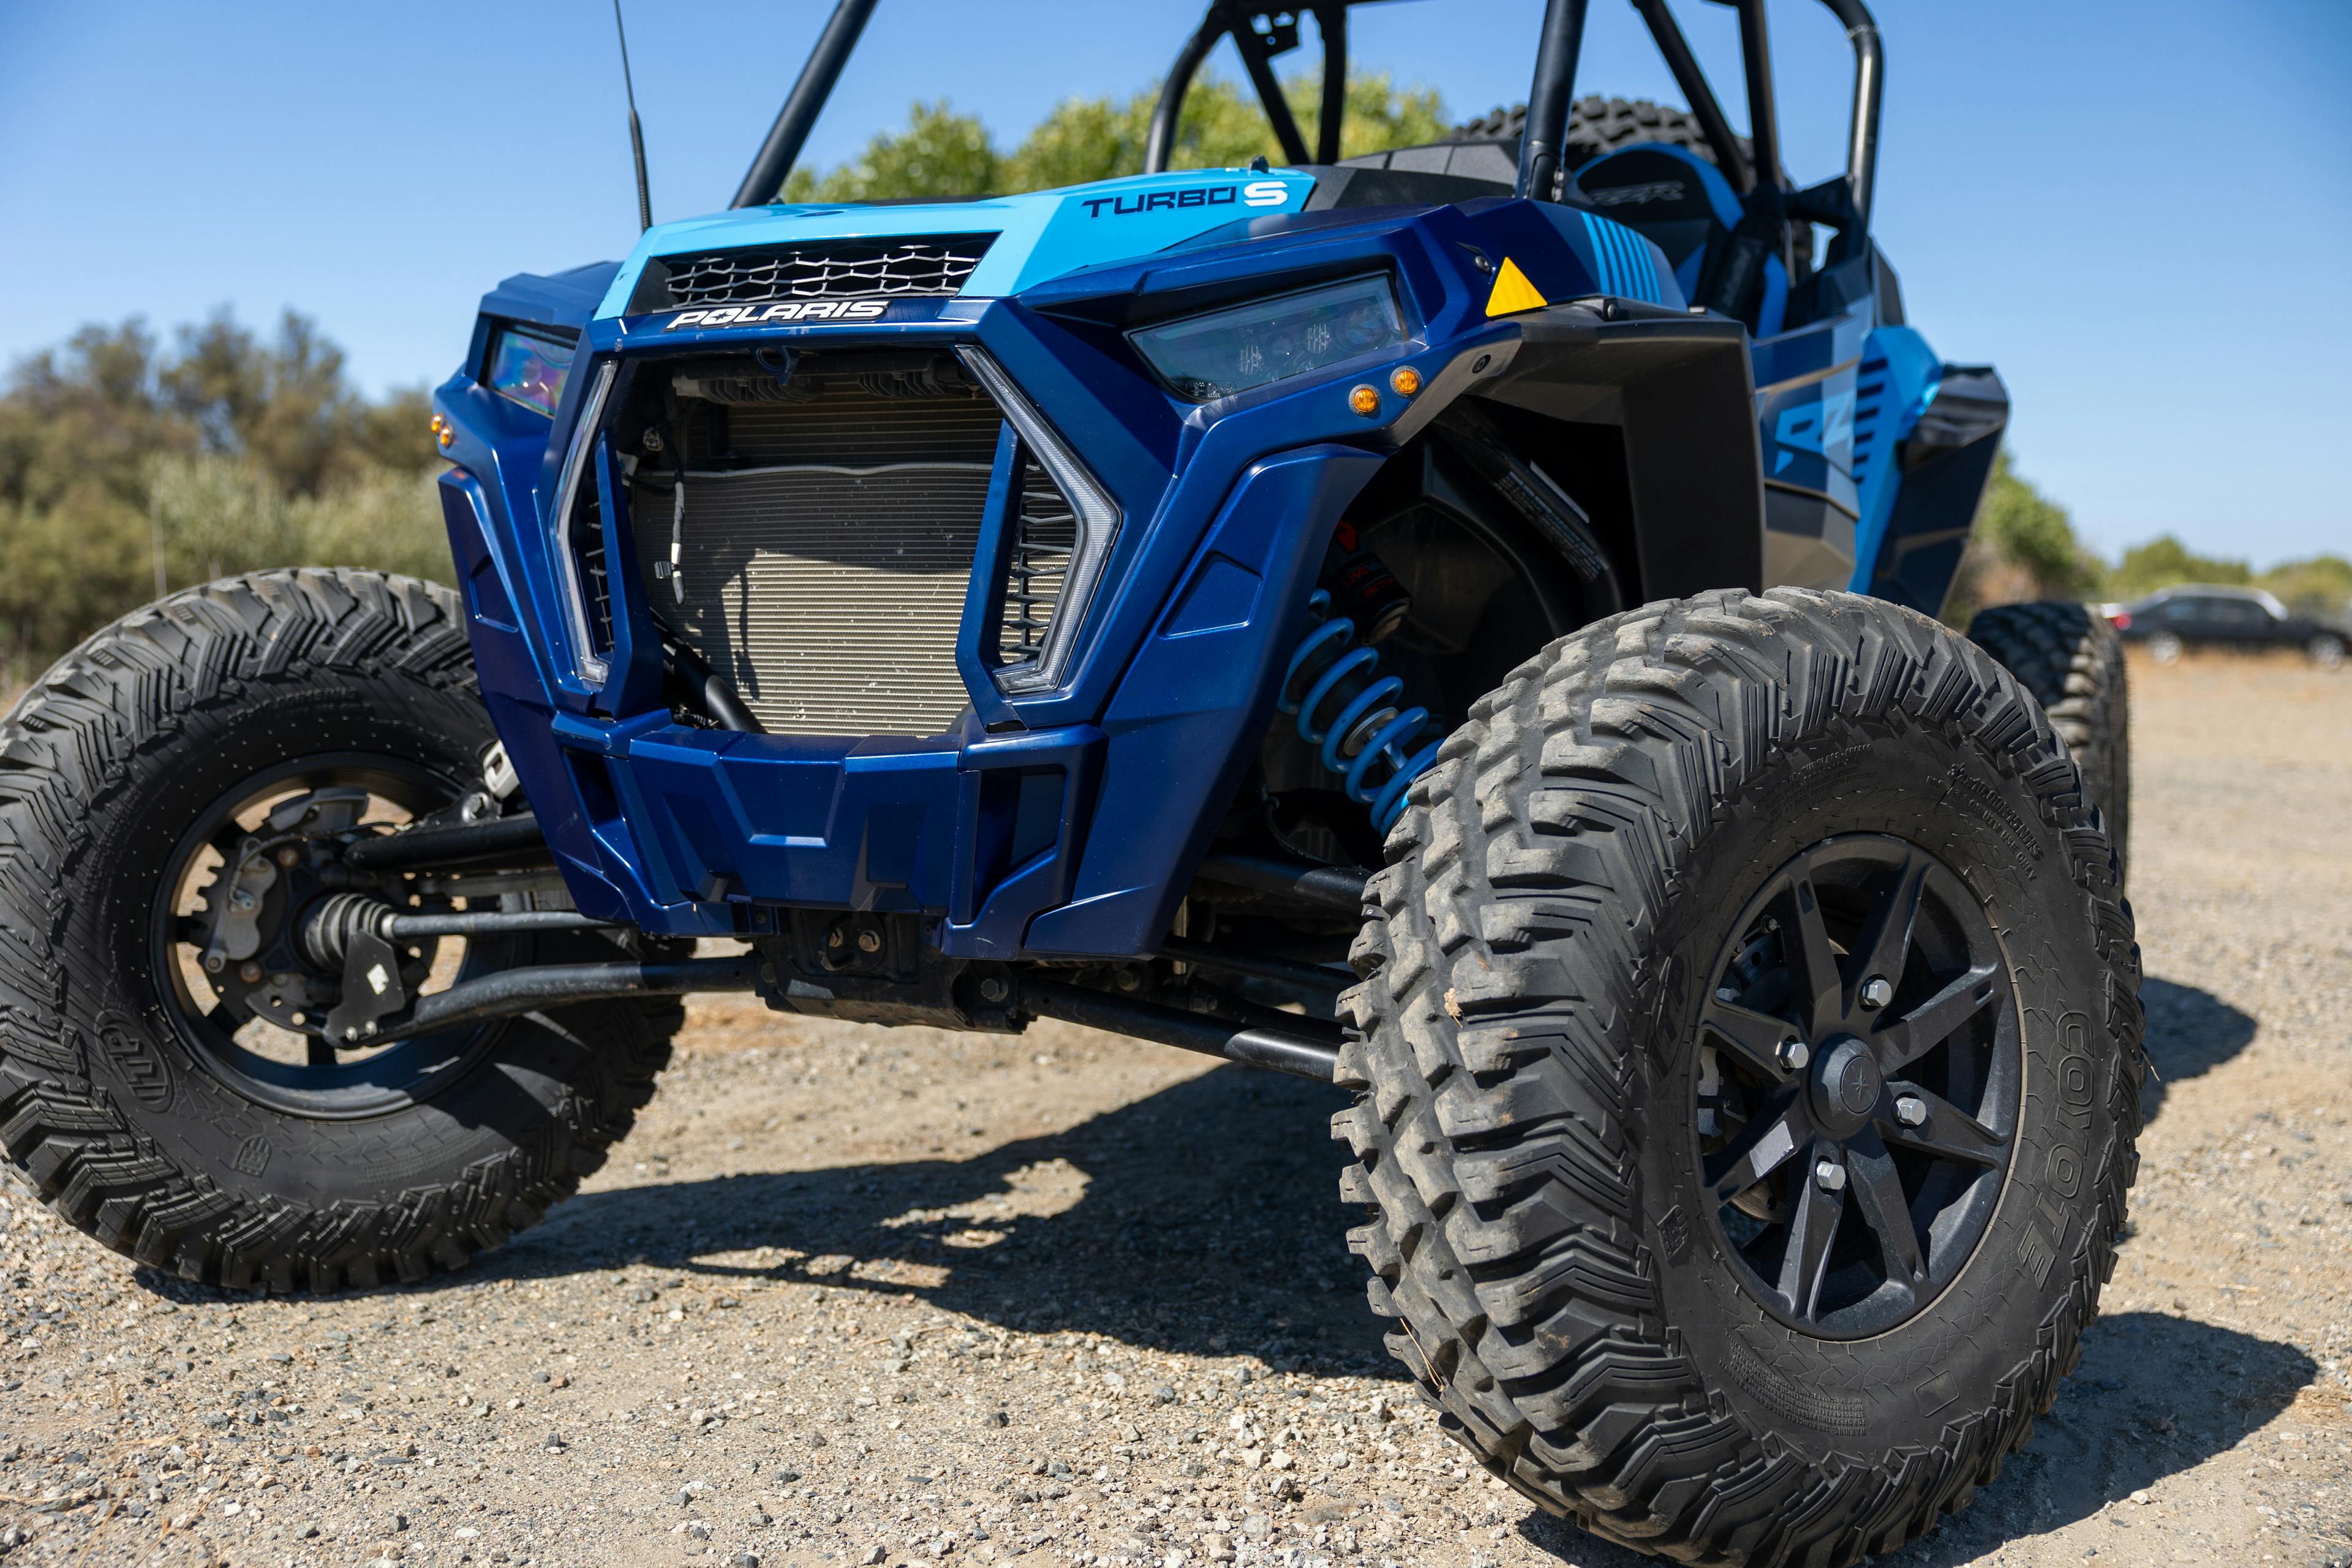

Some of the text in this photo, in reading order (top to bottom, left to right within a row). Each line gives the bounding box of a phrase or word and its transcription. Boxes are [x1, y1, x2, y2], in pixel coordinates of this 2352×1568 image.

[1080, 181, 1288, 219] TURBO S
[665, 301, 891, 330] POLARIS
[2018, 1011, 2095, 1292] COYOTE
